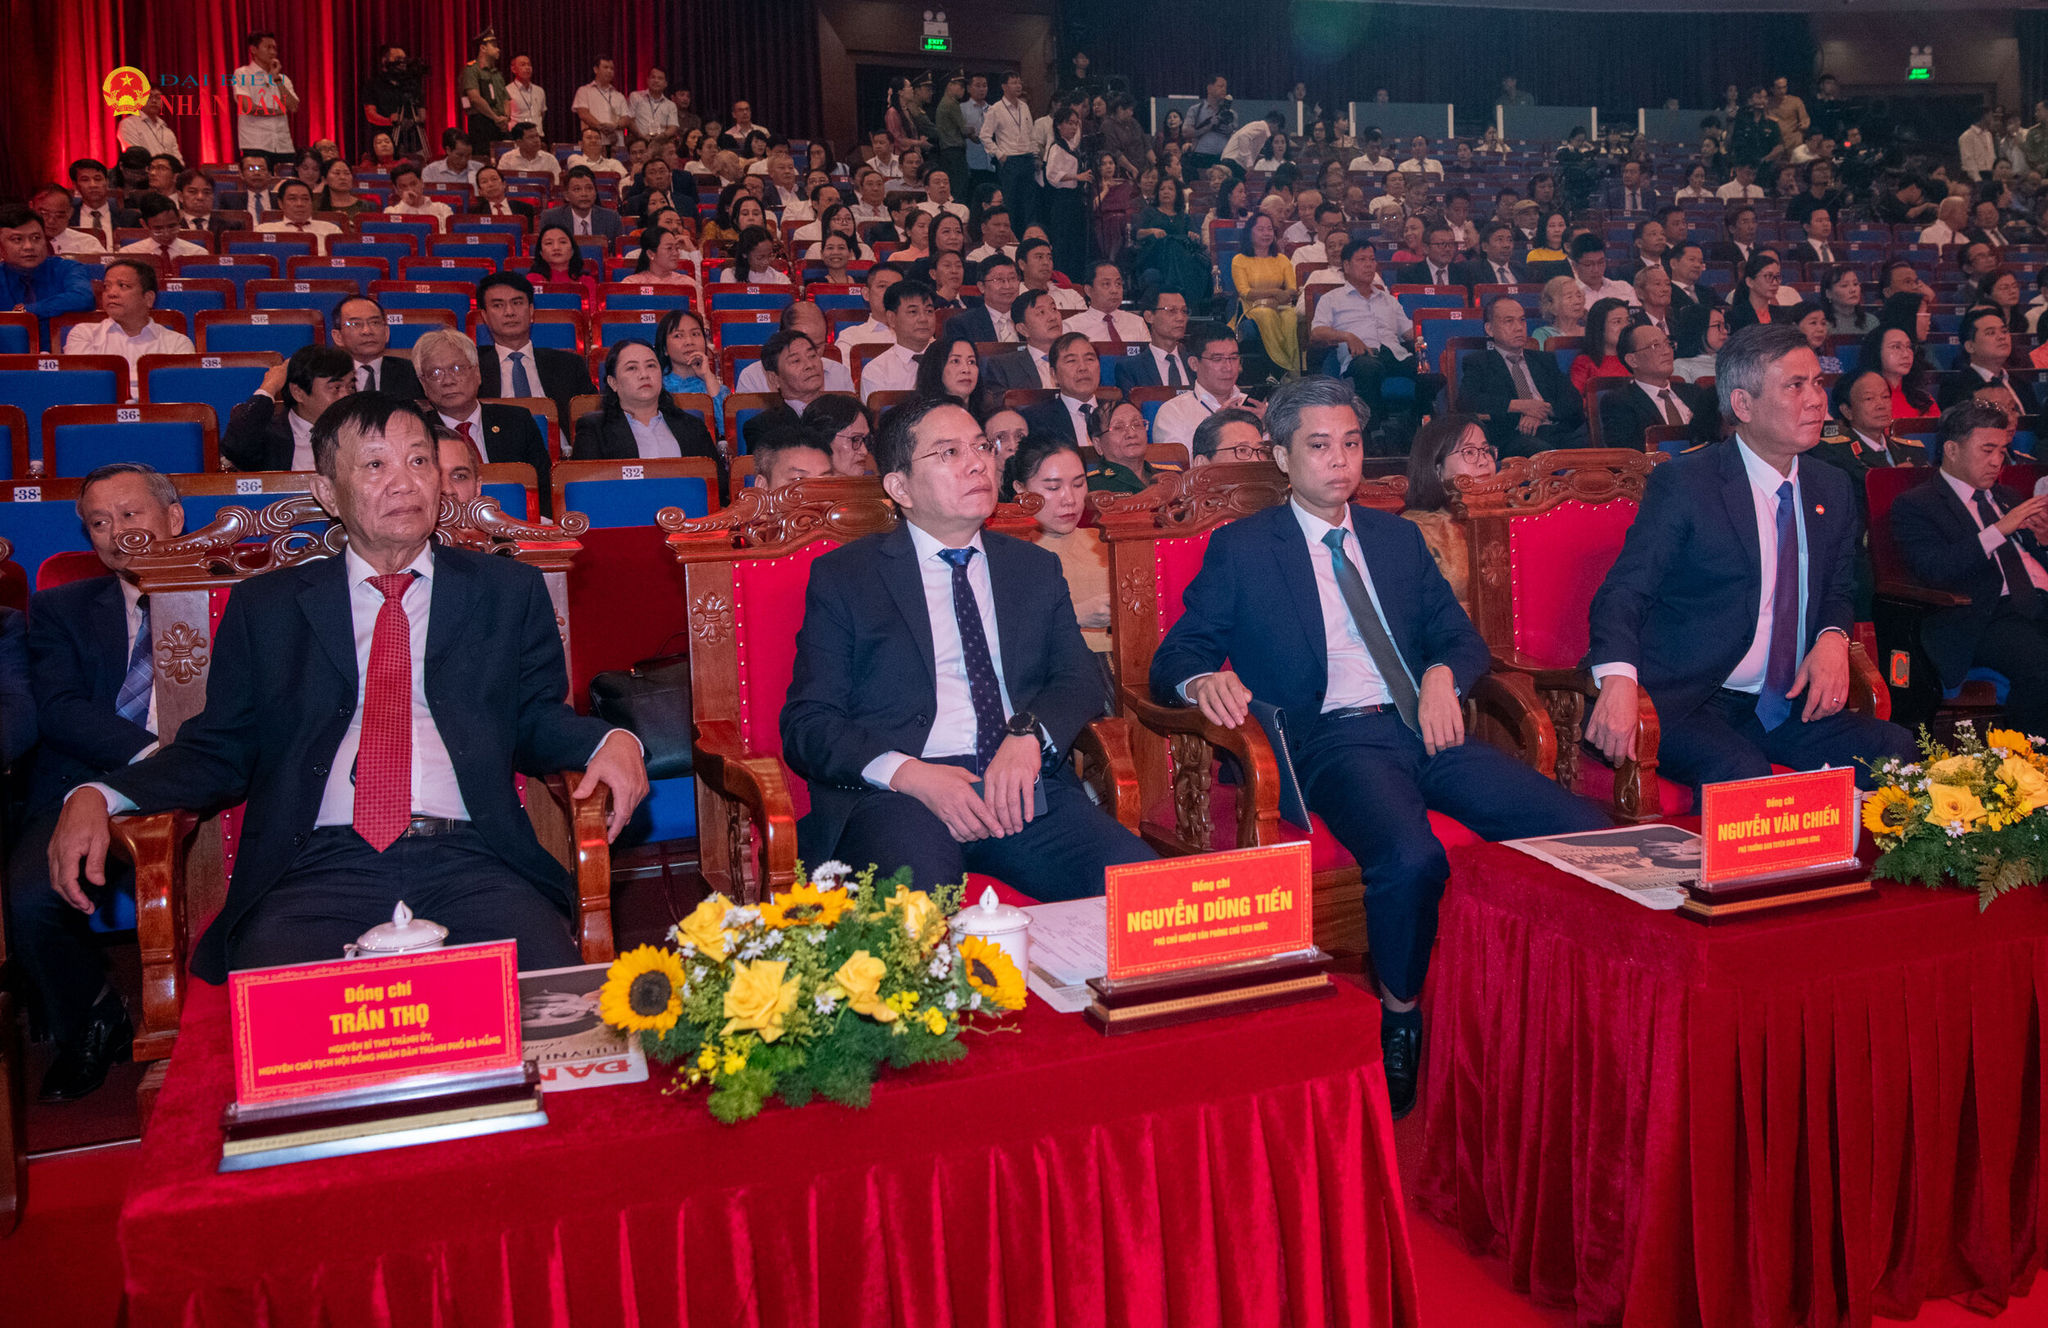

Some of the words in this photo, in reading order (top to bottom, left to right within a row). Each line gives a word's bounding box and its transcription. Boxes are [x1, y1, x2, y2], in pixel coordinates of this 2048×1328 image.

[41, 361, 56, 370] 40
[205, 359, 219, 368] 38
[120, 410, 137, 420] 36
[625, 468, 641, 478] 32
[240, 481, 259, 492] 36
[18, 489, 38, 500] 38
[1892, 653, 1908, 685] C
[1718, 813, 1770, 841] NGUYỄN
[1773, 811, 1799, 834] VĂN
[1802, 803, 1840, 829] CHIẾN
[1127, 898, 1198, 933] NGUYỄN
[1203, 896, 1251, 922] DŨNG
[1255, 885, 1293, 914] TIẾN
[387, 980, 412, 998] chí
[389, 1003, 430, 1028] THỌ
